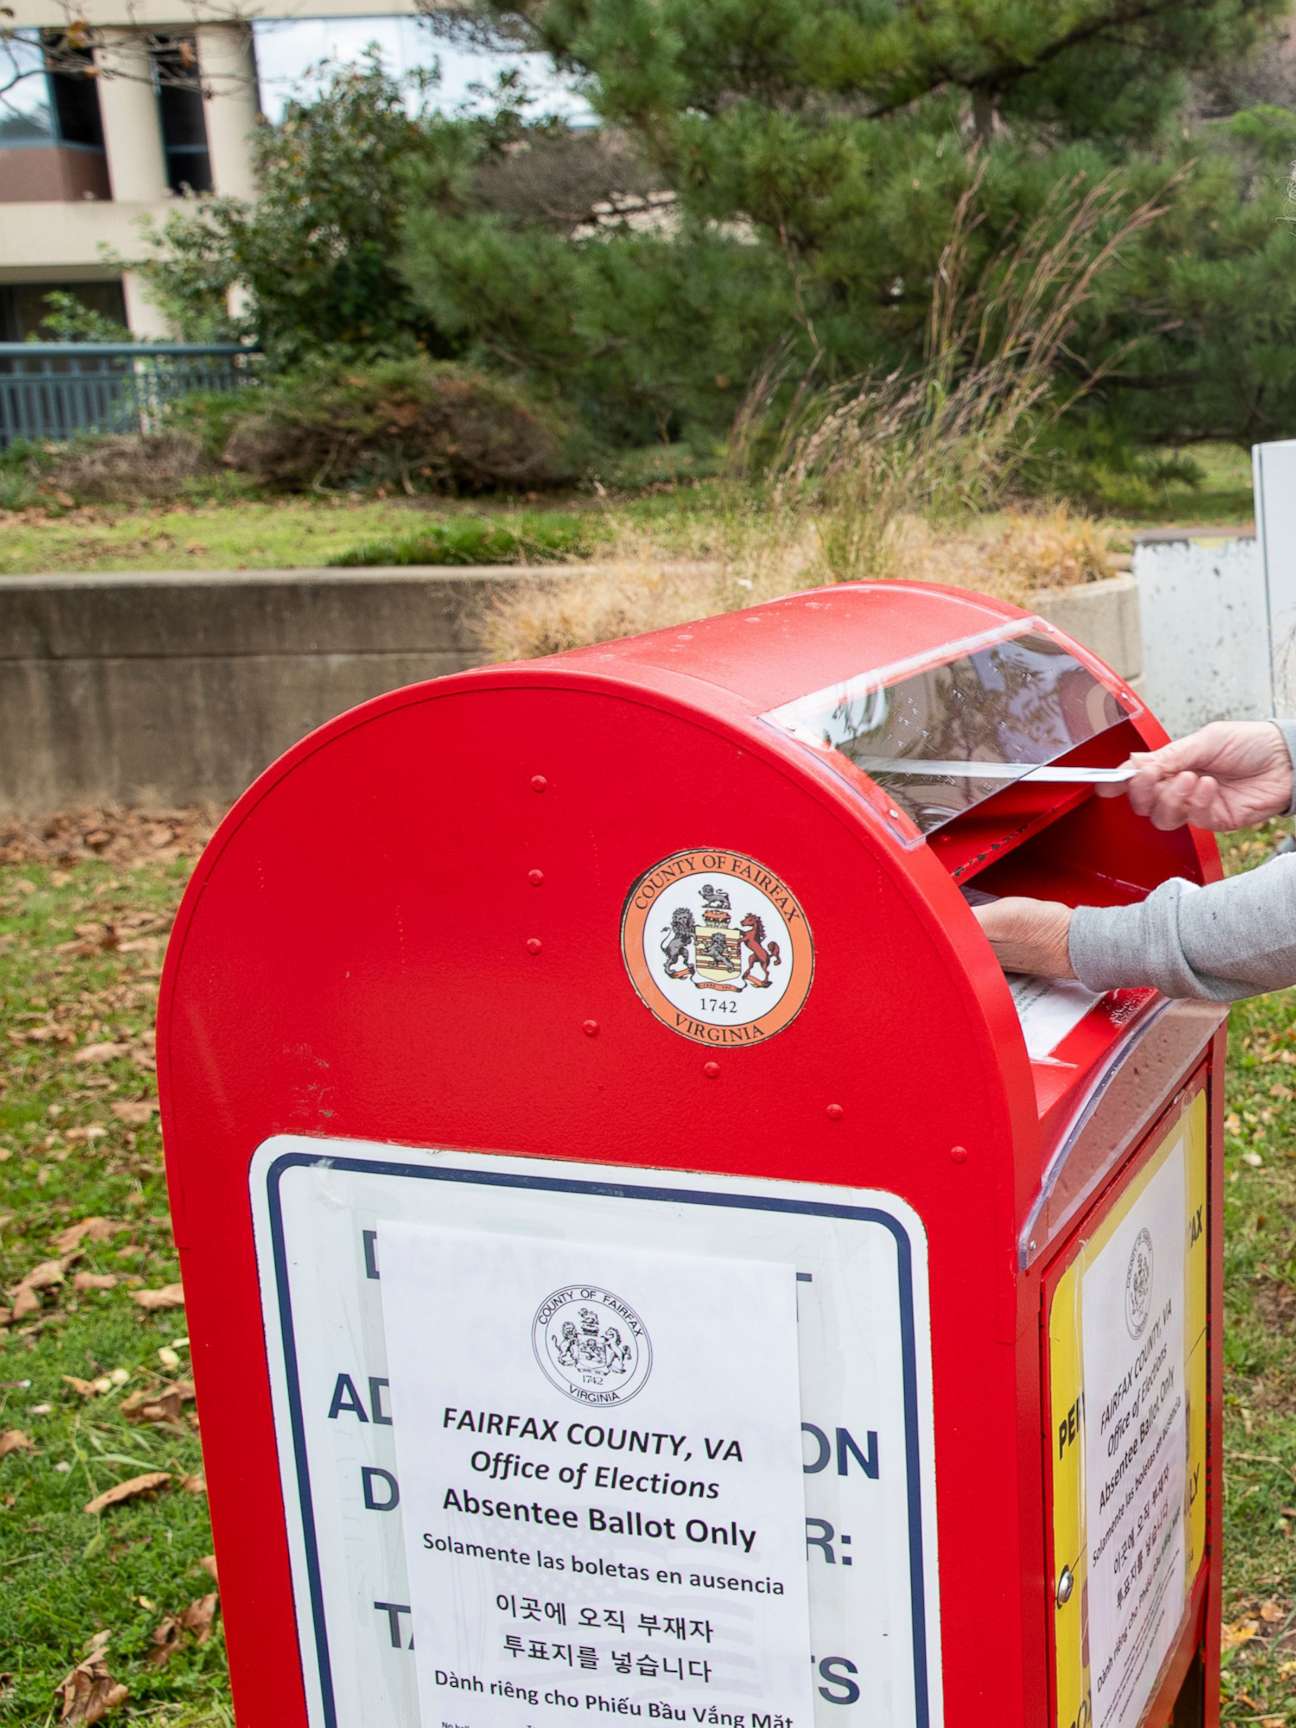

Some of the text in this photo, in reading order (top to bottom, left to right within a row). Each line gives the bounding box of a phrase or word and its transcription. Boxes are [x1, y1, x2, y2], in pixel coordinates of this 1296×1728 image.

[635, 855, 800, 923] COUNTY OF FAIRFAX
[674, 1013, 765, 1043] VIRGINIA
[700, 998, 738, 1013] 1742
[538, 1288, 643, 1337] COUNTY OF FAIRFAX
[569, 1384, 620, 1403] VIRGINIA
[582, 1375, 604, 1386] 1742
[1100, 1366, 1133, 1435] FAIRFAX
[1108, 1343, 1167, 1457] Office of Elections
[443, 1407, 743, 1463] FAIRFAX COUNTY, VA
[1099, 1437, 1138, 1515] Absentee
[1140, 1395, 1160, 1445] Ballot
[471, 1450, 720, 1499] Office of Elections
[443, 1488, 756, 1553] Absentee Ballot Only
[423, 1533, 784, 1595] Solamente las boletas en ausencia
[496, 1594, 713, 1643] 이곳에 오직 부재자
[503, 1634, 712, 1683] 투표지를 넣습니다
[435, 1670, 484, 1693] Dành
[490, 1680, 538, 1705] riêng
[544, 1689, 579, 1708] cho
[585, 1695, 641, 1716] Phiếu
[649, 1701, 686, 1722] Bầu
